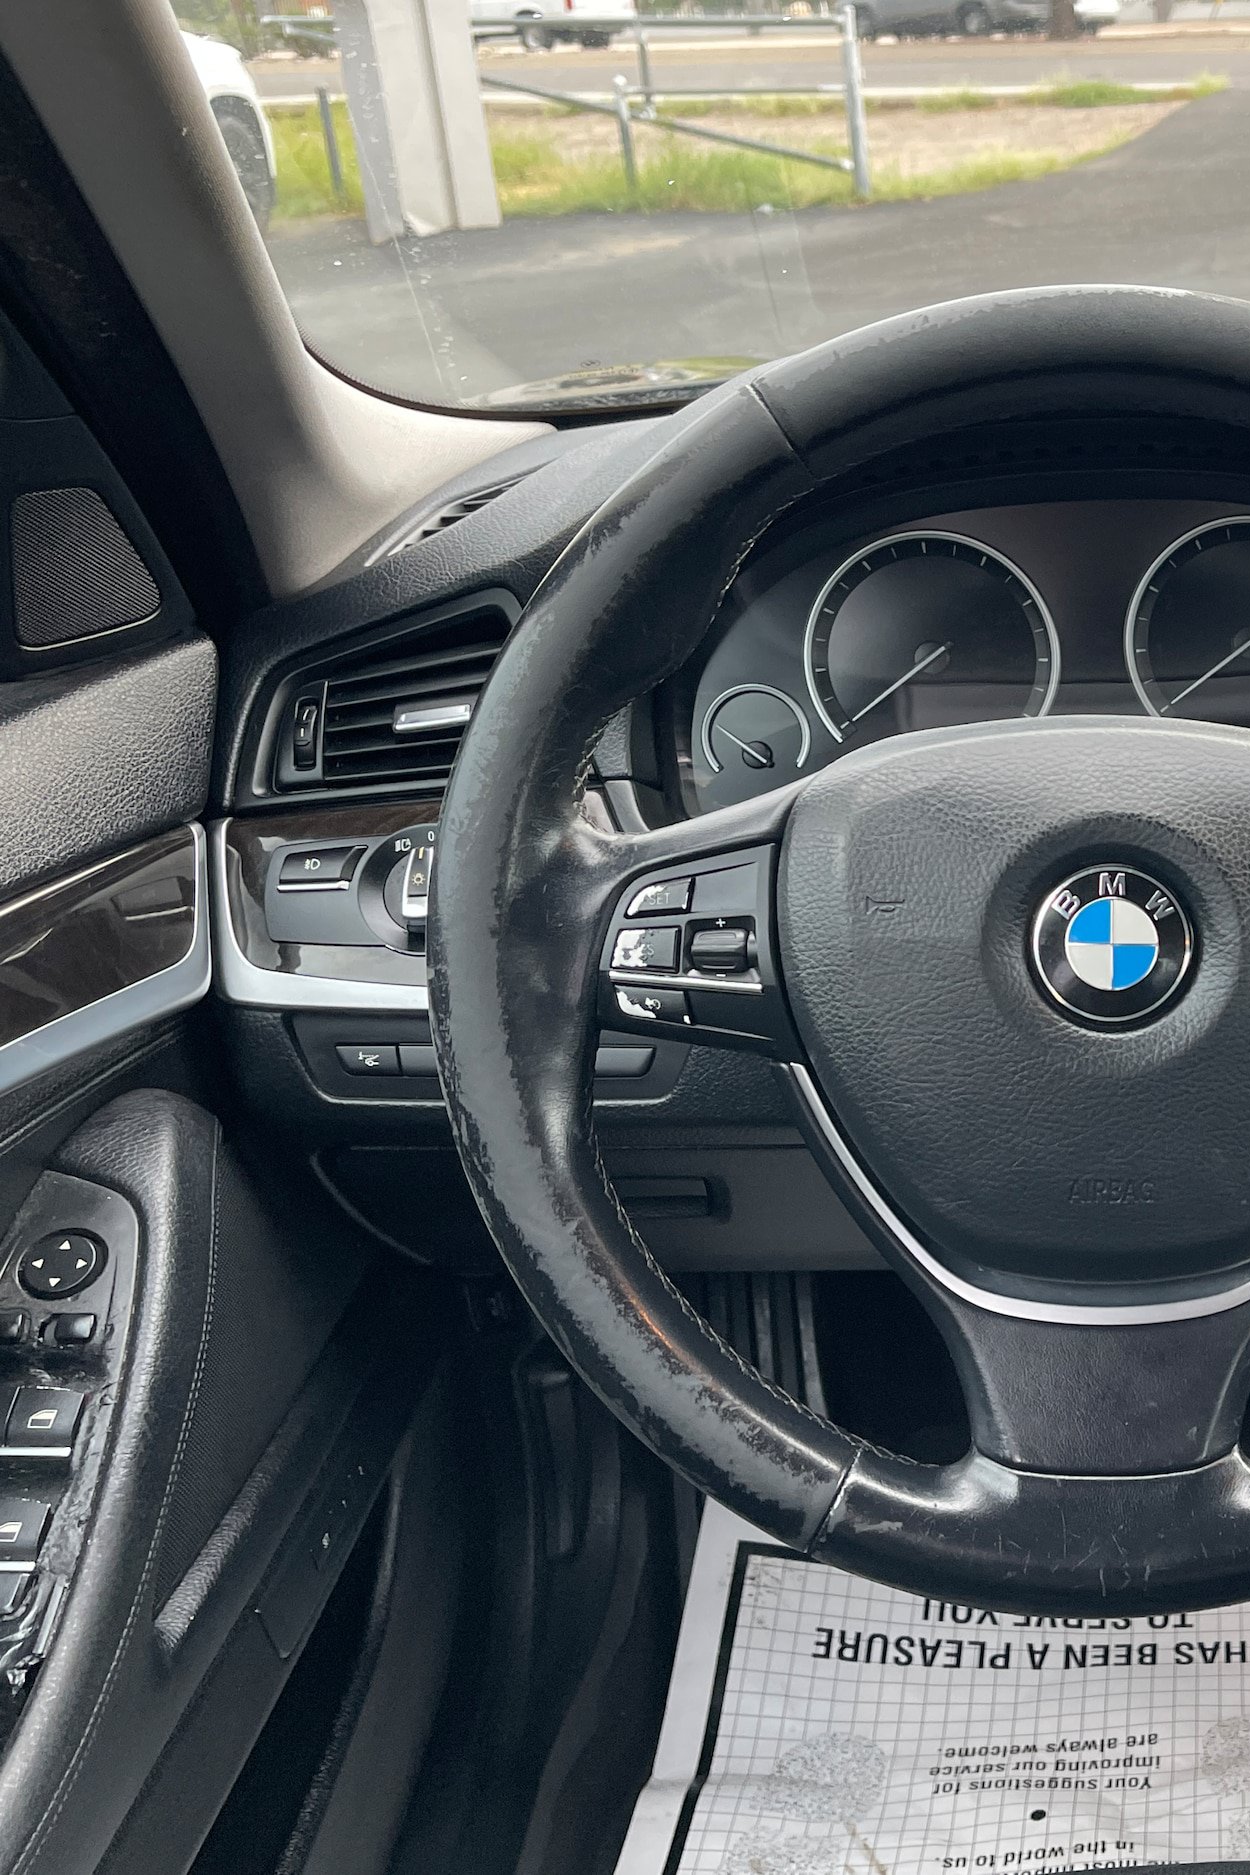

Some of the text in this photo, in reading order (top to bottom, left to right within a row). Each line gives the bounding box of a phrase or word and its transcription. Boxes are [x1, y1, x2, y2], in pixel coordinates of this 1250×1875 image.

[649, 893, 671, 906] SET
[1051, 872, 1176, 921] BMW
[1067, 1180, 1155, 1204] AIRBAG
[811, 1627, 1011, 1670] PLEASURE
[1027, 1643, 1050, 1670] A
[1063, 1643, 1158, 1670] BEEN
[1174, 1641, 1247, 1665] HAS
[937, 1733, 1158, 1760] are always welcome.
[929, 1755, 1160, 1777] improving our service
[932, 1776, 1152, 1795] Your suggestions for
[935, 1841, 1134, 1869] in the world to us.
